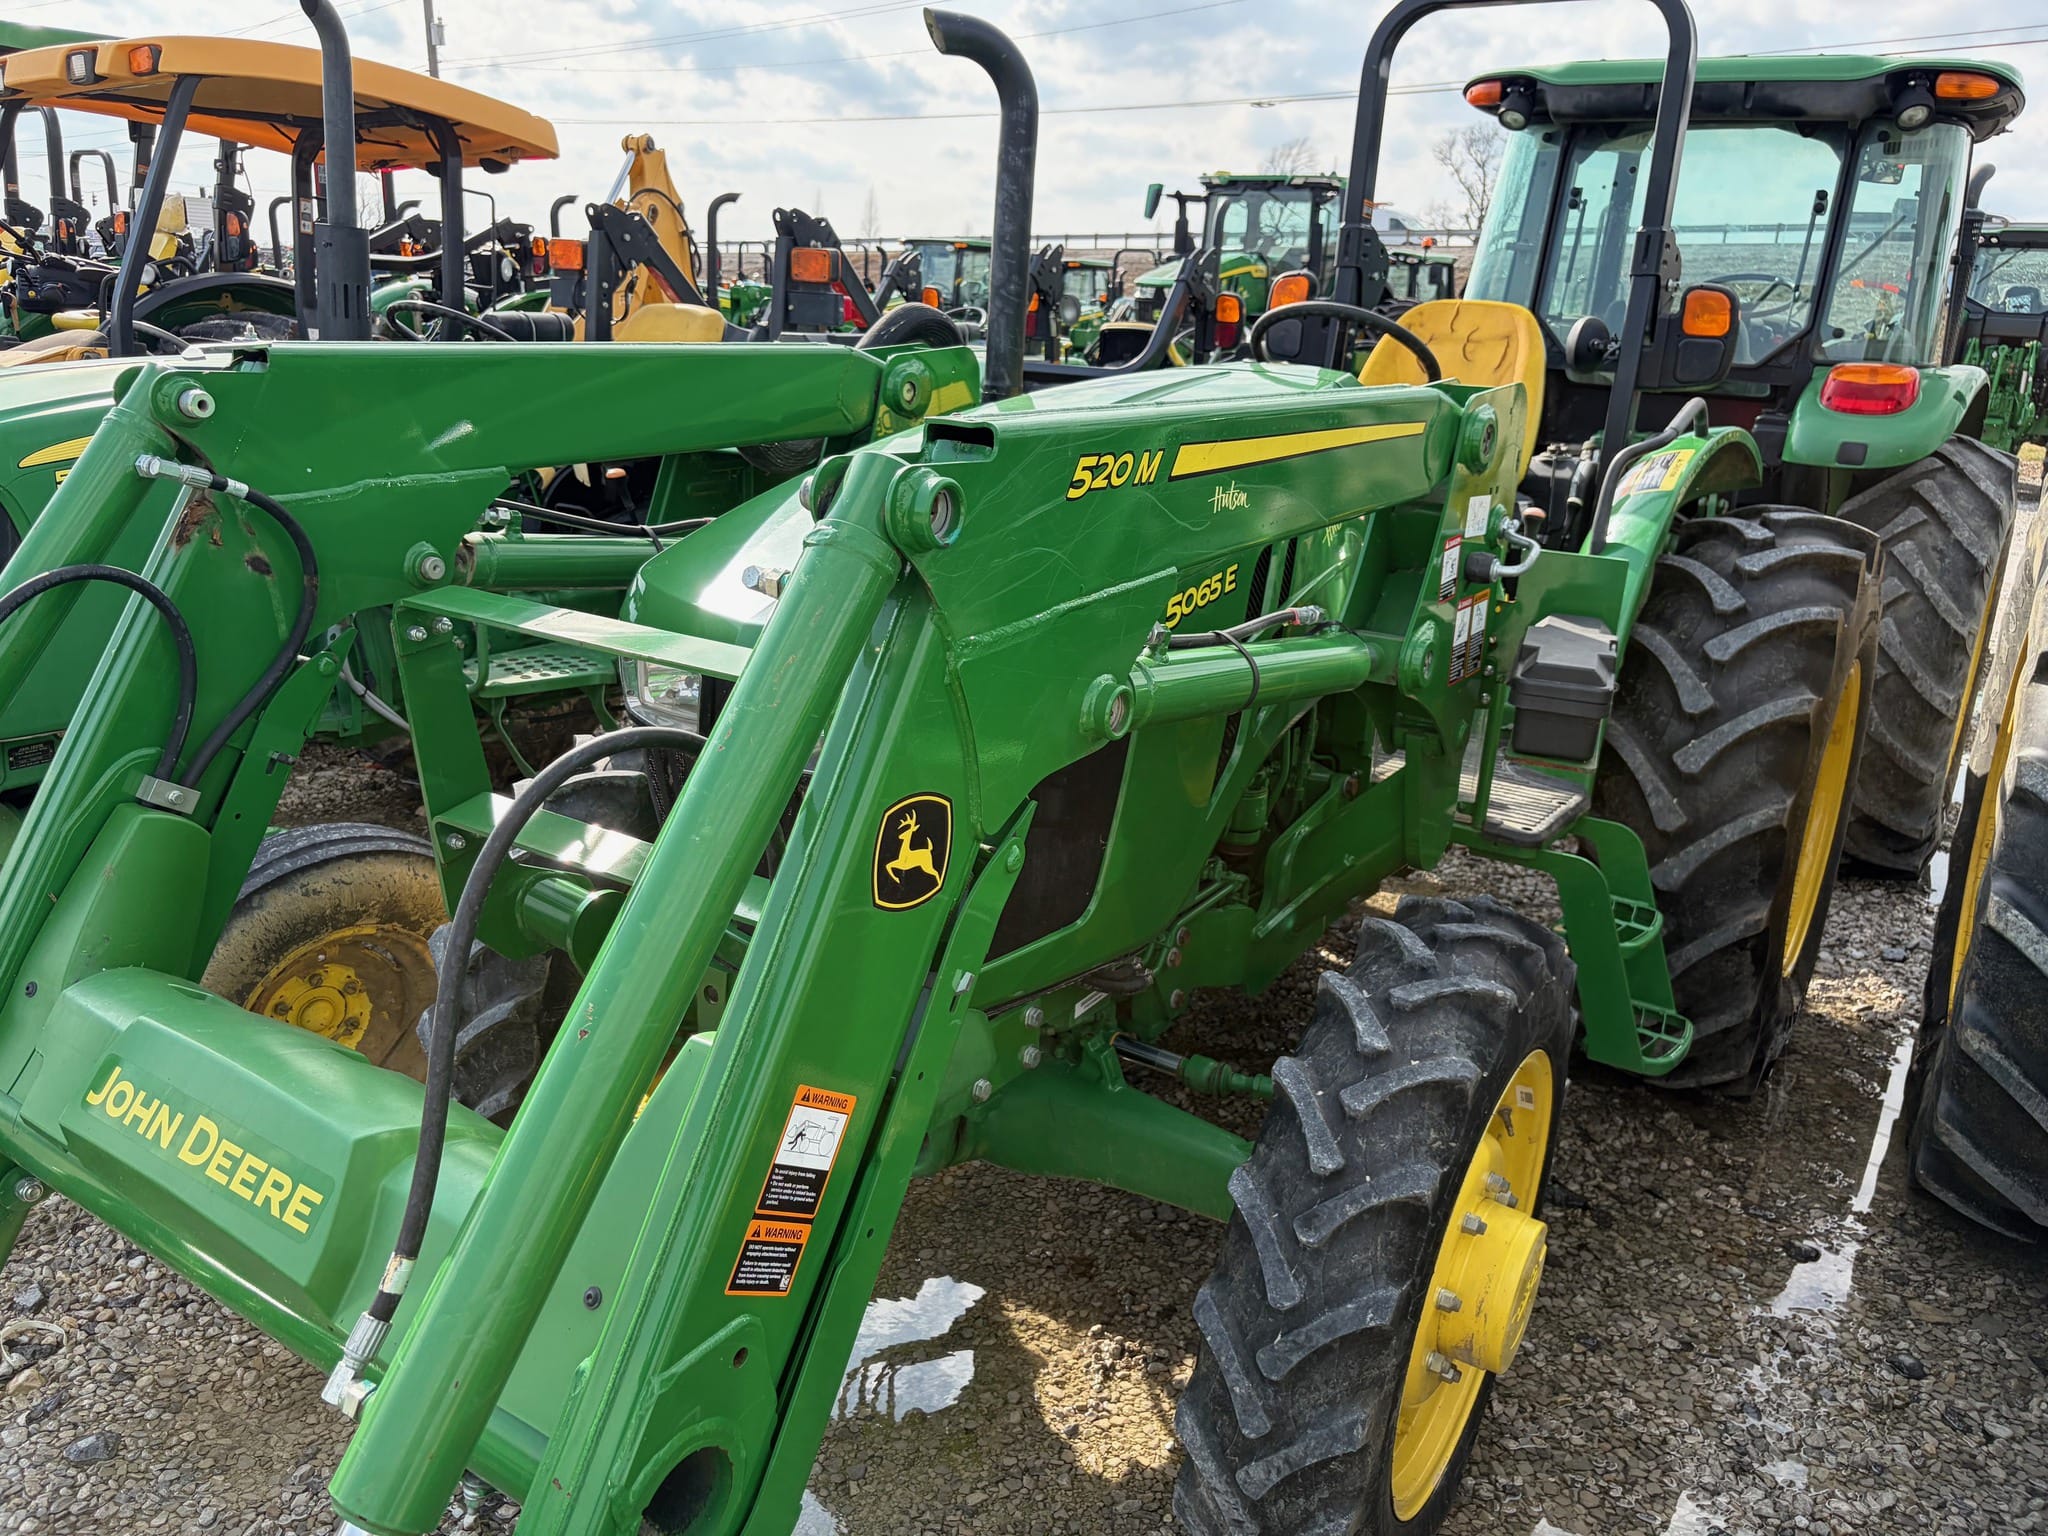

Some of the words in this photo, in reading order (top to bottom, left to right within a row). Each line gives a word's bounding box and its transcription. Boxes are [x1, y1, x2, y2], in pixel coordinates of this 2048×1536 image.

[1208, 480, 1251, 514] Hutson
[811, 1092, 848, 1109] WARNING
[86, 1066, 184, 1150] JOHN
[177, 1114, 324, 1234] DEERE
[765, 1227, 803, 1240] WARNING
